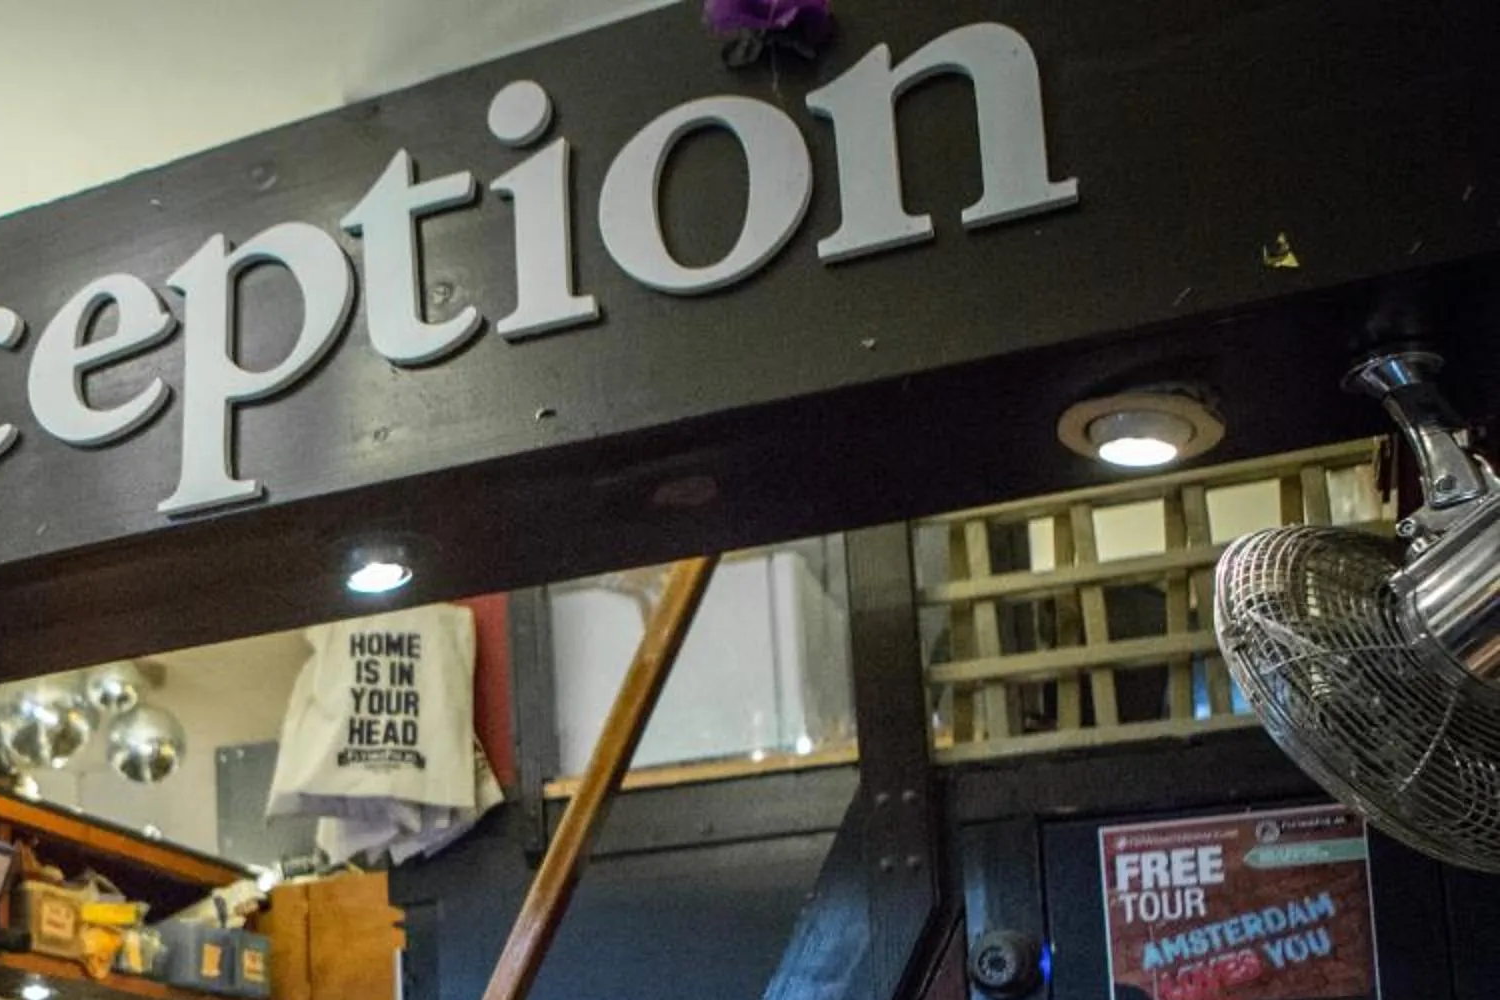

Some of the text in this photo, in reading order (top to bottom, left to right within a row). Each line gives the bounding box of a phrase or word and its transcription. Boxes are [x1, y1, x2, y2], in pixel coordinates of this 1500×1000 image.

[350, 632, 421, 658] HOME
[356, 659, 414, 686] IS IN
[351, 687, 419, 717] YOUR
[348, 718, 418, 746] HEAD
[1115, 845, 1224, 893] FREE
[1118, 887, 1208, 923] TOUR
[1143, 891, 1336, 970] AMSTERDAM
[1263, 927, 1332, 969] YOU
